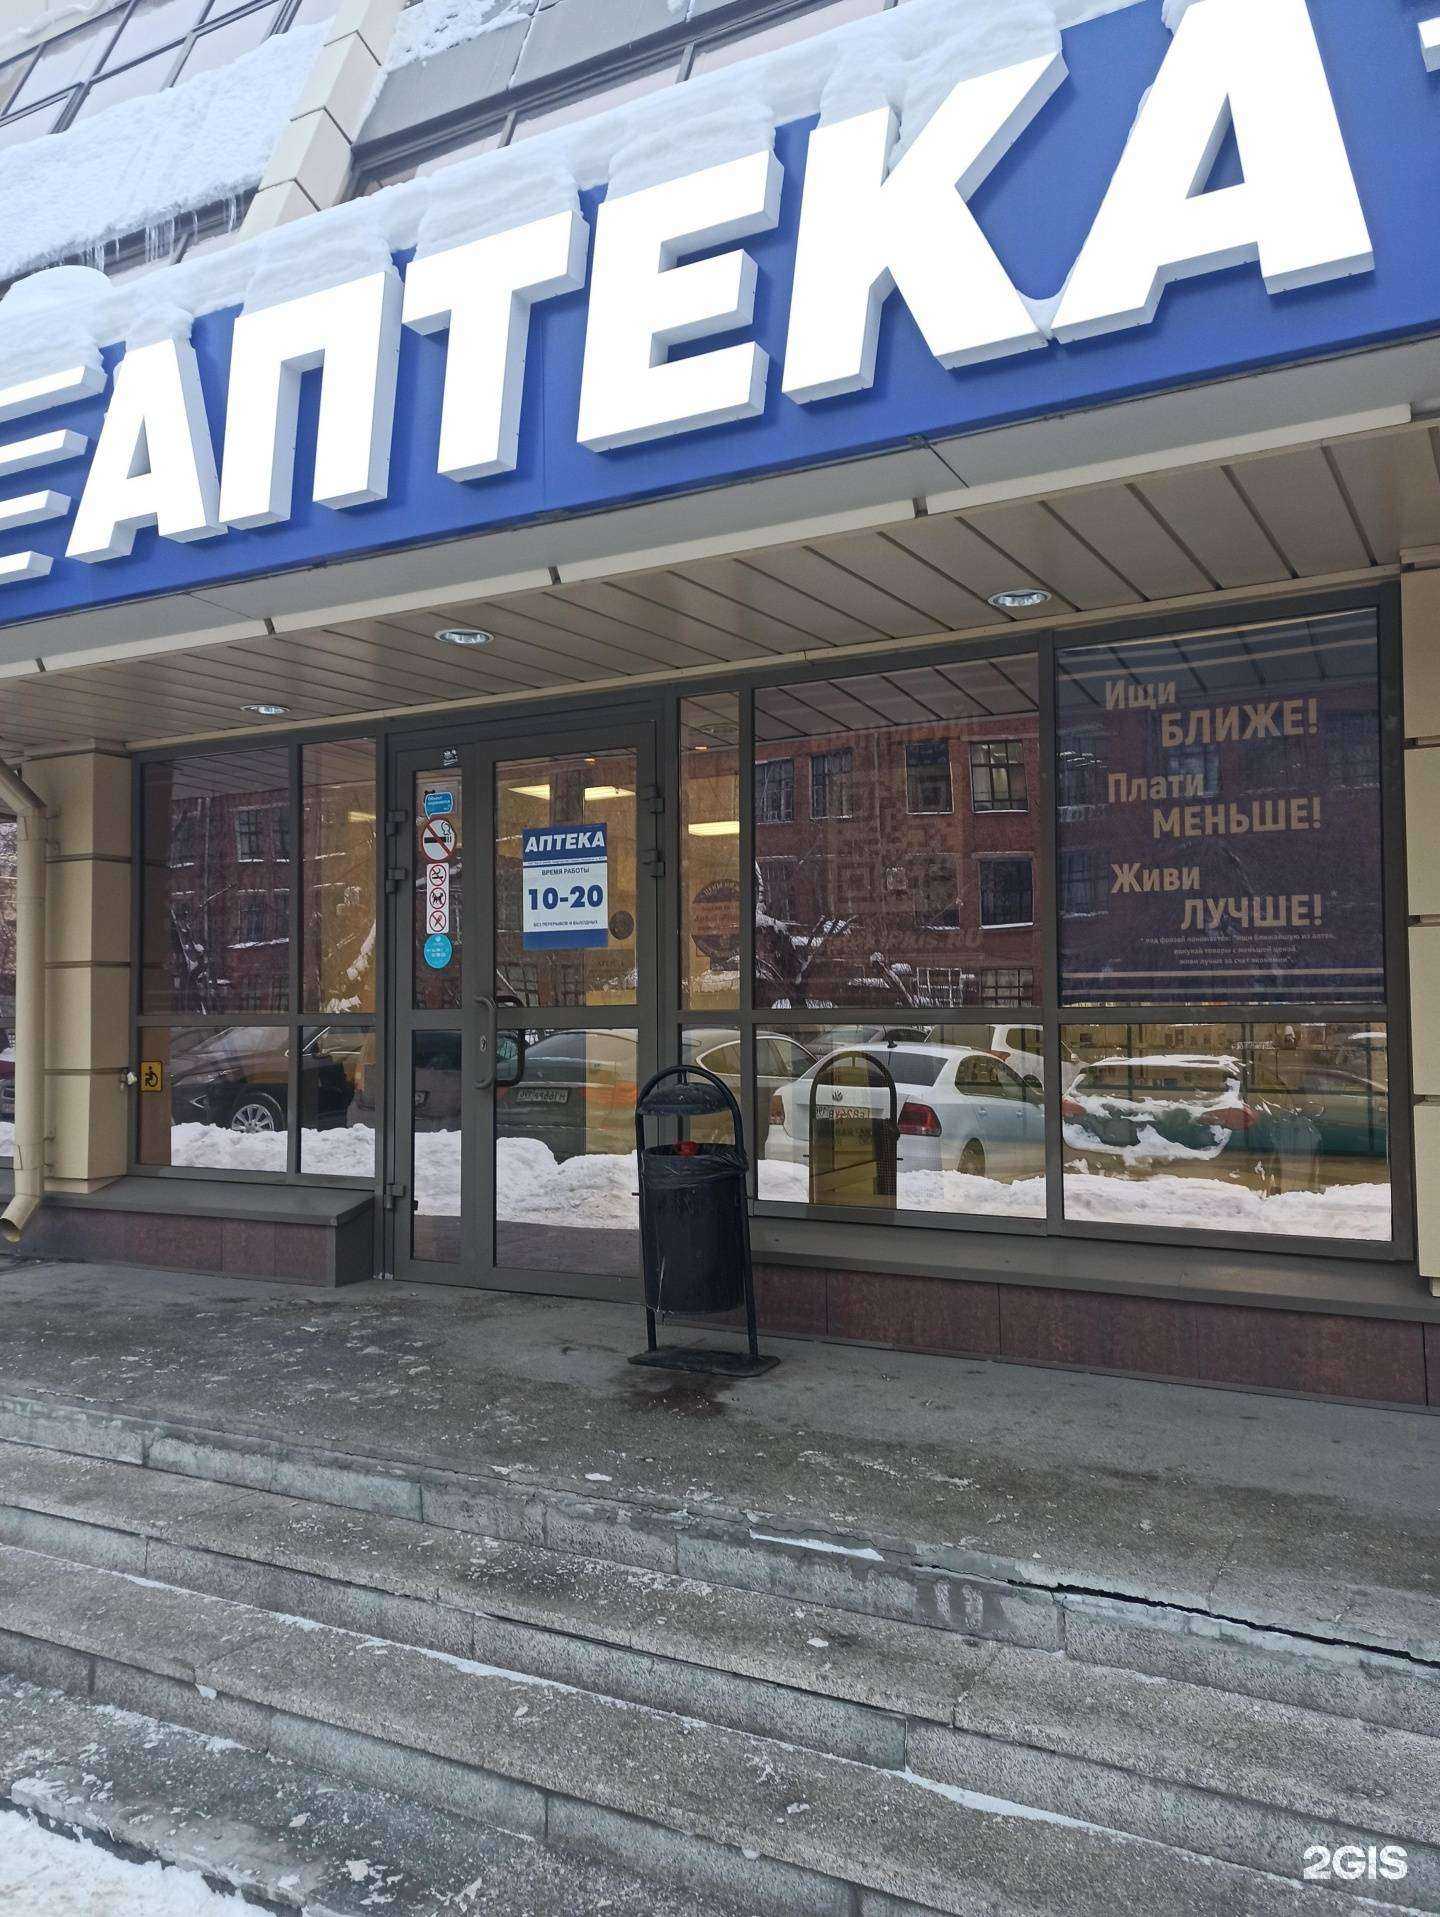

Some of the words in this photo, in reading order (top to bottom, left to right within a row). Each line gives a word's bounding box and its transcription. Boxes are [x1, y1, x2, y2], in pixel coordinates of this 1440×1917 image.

[65, 0, 1375, 564] АПТЕКА
[1105, 680, 1176, 710] Ищи
[1161, 698, 1319, 747] БЛИЖЕ!
[1107, 772, 1204, 803] Плати
[1152, 797, 1322, 839] МЕНЬШЕ!
[525, 830, 605, 853] АПТЕКА
[541, 868, 563, 876] ВРЕМЯ
[564, 867, 590, 875] РАБОТЫ
[1110, 863, 1200, 894] Живи
[528, 884, 604, 911] 10-20
[1181, 894, 1322, 930] ЛУЧШЕ!
